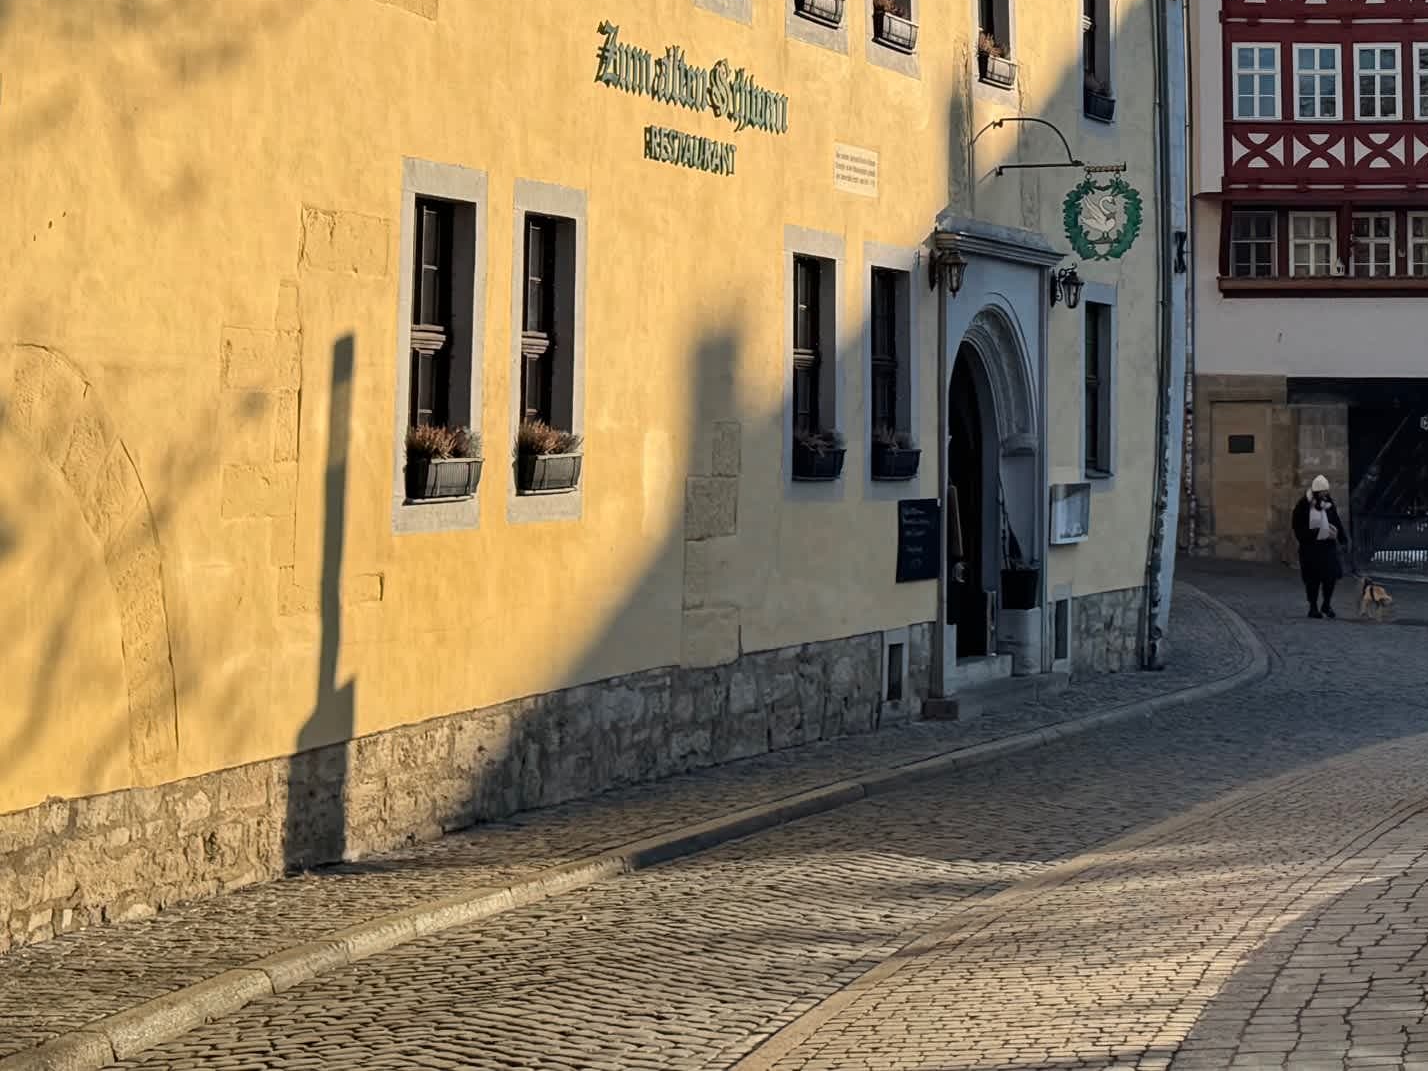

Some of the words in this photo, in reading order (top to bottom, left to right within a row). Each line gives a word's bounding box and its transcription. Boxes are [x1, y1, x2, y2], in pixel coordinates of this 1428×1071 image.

[595, 19, 651, 97] Zum
[651, 44, 709, 113] alten
[707, 57, 788, 135] Schwan
[644, 125, 737, 176] RESTAURANT
